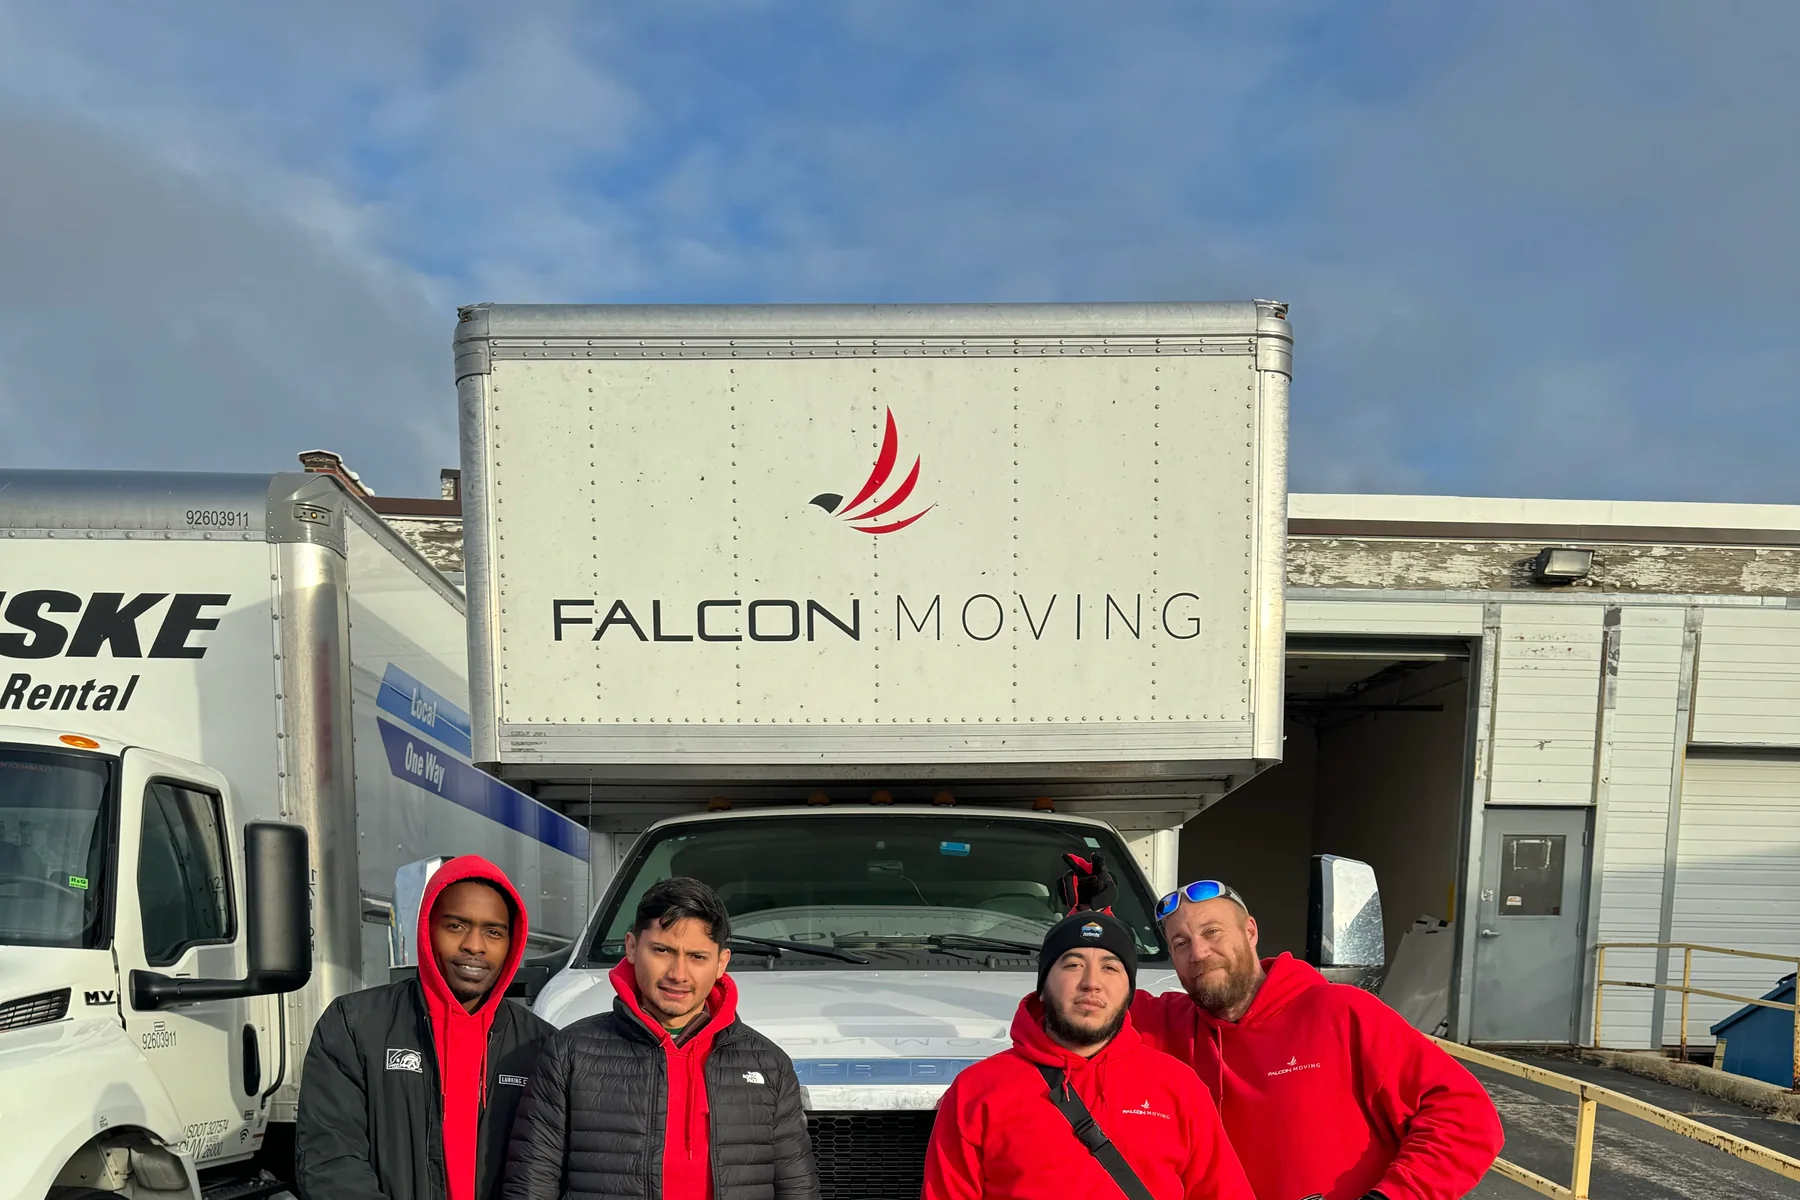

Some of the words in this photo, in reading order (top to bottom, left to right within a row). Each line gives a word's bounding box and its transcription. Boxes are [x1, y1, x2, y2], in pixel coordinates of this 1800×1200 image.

[186, 510, 249, 527] 92603911
[0, 589, 232, 659] SKE
[554, 598, 860, 643] FALCON
[895, 592, 1202, 642] MOVING
[0, 673, 140, 711] Rental
[411, 687, 437, 728] Local
[405, 741, 424, 776] One
[425, 750, 445, 792] Way
[84, 990, 114, 1002] MV
[142, 1031, 177, 1050] 92603911
[1293, 1062, 1321, 1072] MOVING
[1146, 1110, 1170, 1120] MOVING
[206, 1119, 230, 1136] 327574
[202, 1142, 224, 1159] 26000
